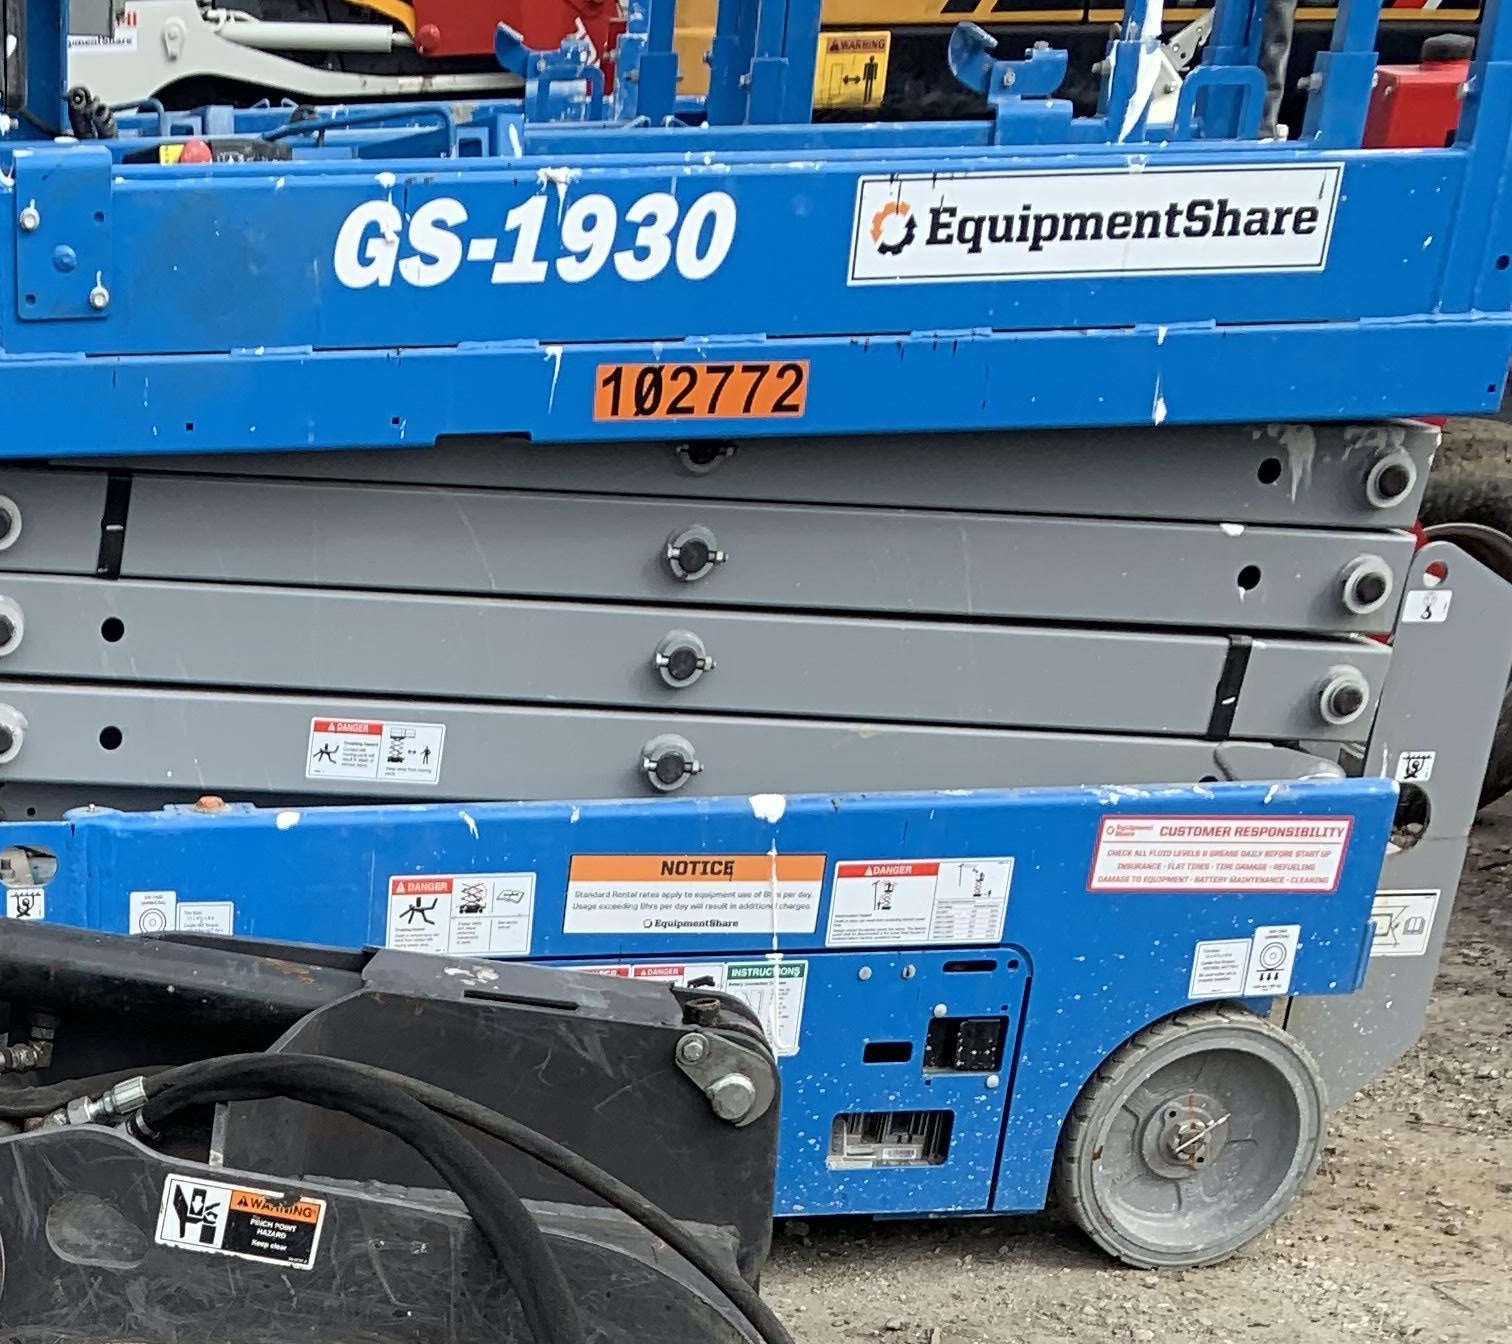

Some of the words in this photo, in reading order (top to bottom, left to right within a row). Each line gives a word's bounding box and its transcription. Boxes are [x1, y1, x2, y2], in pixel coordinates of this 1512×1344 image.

[841, 39, 885, 50] WARNING
[925, 198, 1319, 254] EquipmentShare
[334, 191, 737, 288] GS-1930
[601, 363, 804, 417] 102772
[337, 722, 369, 733] DANGER
[1159, 826, 1231, 837] CUSTOMER
[1233, 826, 1345, 838] RESPONSIBILITY
[1107, 849, 1132, 857] CHECK
[1134, 849, 1147, 857] ALL
[1149, 849, 1172, 857] FLUID
[1173, 849, 1201, 857] LEVELS
[1240, 850, 1262, 858] DAILY
[1295, 850, 1319, 858] START
[660, 860, 735, 876] NOTICE
[873, 865, 912, 876] DANGER
[407, 881, 448, 892] DANGER
[574, 890, 610, 898] Standard
[612, 890, 637, 898] Rental
[661, 890, 683, 900] apply
[684, 890, 693, 898] to
[694, 890, 736, 900] equipment
[753, 890, 762, 898] of
[782, 891, 797, 900] per
[572, 902, 597, 911] Usage
[598, 902, 639, 911] exceeding
[674, 902, 688, 911] day
[690, 902, 704, 910] will
[704, 902, 728, 910] result
[729, 902, 737, 910] in
[738, 902, 778, 910] additionl
[654, 919, 739, 929] EquipmentShare
[731, 966, 801, 977] INSTRUCONS
[250, 1218, 273, 1230] PINCH
[274, 1221, 298, 1233] POINT
[256, 1228, 287, 1239] HAZARD
[251, 1239, 269, 1250] Keep
[269, 1241, 288, 1251] clear
